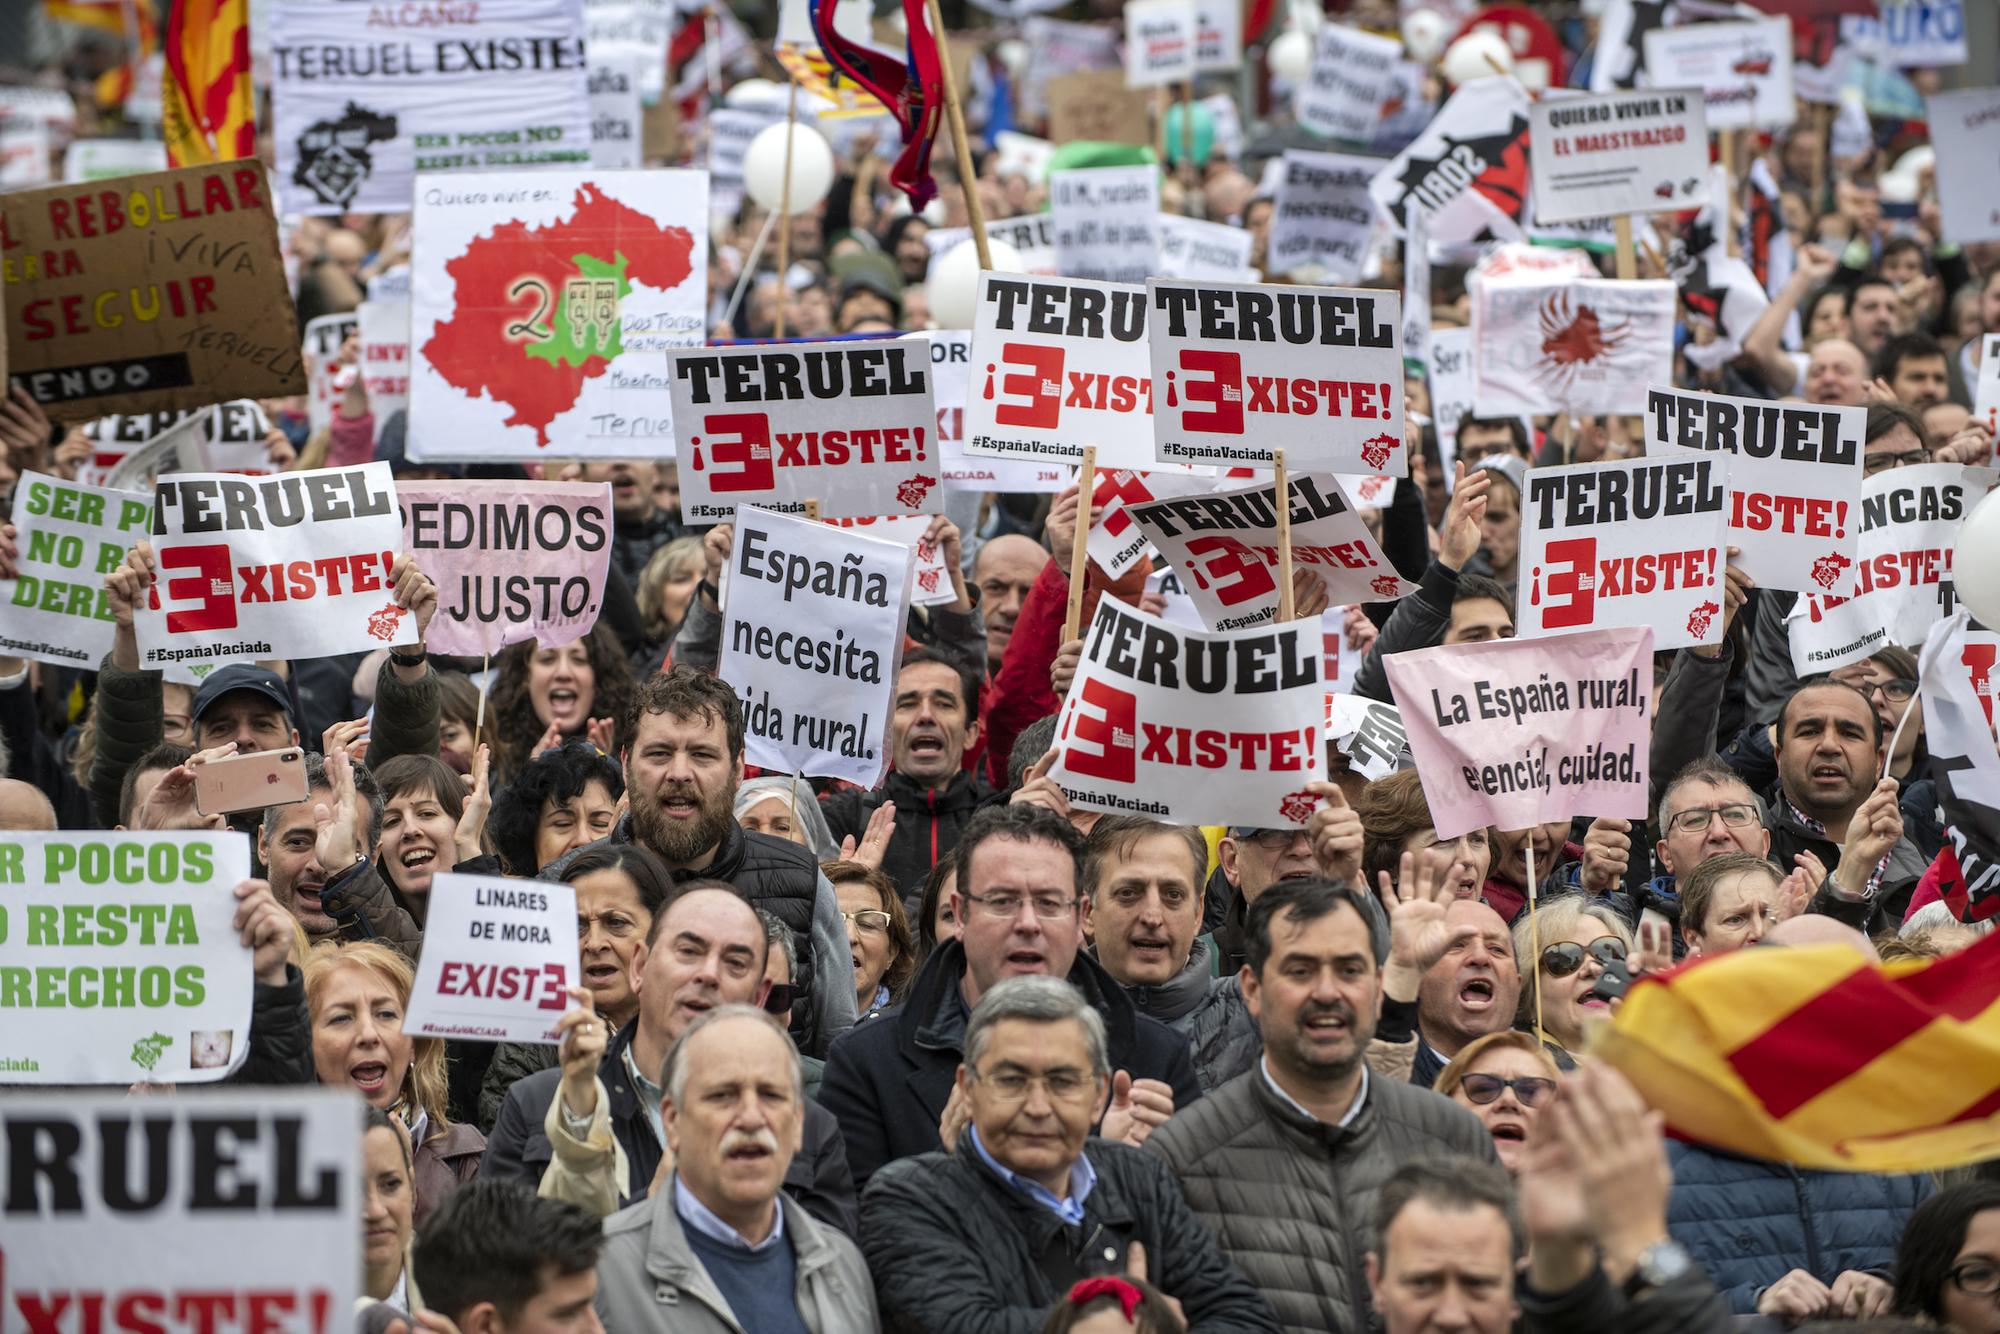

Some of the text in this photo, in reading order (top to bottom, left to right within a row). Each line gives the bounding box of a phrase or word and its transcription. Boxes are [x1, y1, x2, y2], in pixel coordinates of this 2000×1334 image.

[273, 37, 588, 80] TERUEL EXISTE!
[1549, 97, 1687, 128] QUIERO VIVIR EN
[1553, 125, 1686, 156] EL MAESTRAZGO
[0, 170, 263, 250] L REBOLLAR
[425, 188, 488, 207] Quiero
[3, 249, 84, 283] ERRA
[22, 276, 218, 341] SEGUIR
[986, 280, 1148, 342] TERU
[1155, 287, 1393, 348] TERUEL
[178, 324, 300, 385] TERUEL!
[676, 348, 926, 404] TERUEL
[11, 364, 150, 401] ENDO
[983, 342, 1153, 429] ¡EXIST
[590, 413, 672, 438] Terue
[972, 435, 1084, 457] #EspañaVaciada
[1648, 389, 1857, 466] TERUEL
[1163, 442, 1274, 462] #EspañaVaciada
[25, 481, 106, 527] SER
[153, 471, 391, 535] TERUEL
[1131, 476, 1348, 538] TERUEL
[1530, 460, 1724, 530] TERUEL
[1728, 490, 1849, 539] ISTE!
[27, 528, 84, 569] NO
[399, 503, 606, 552] EDIMOS
[740, 527, 889, 608] España
[11, 574, 117, 622] DERE
[450, 575, 596, 622] JUSTO.
[1215, 606, 1278, 632] #EspañaVa
[0, 635, 89, 661] EspañaVaciada
[147, 640, 272, 663] #EspañaVaciada
[732, 619, 881, 684] necesita
[1088, 601, 1318, 694] TERUEL
[1807, 626, 1887, 663] #SalvemosTeruel
[1431, 667, 1645, 727] La España rural,
[792, 712, 874, 760] rural.
[1056, 784, 1170, 816] spañaVaciada
[44, 841, 214, 885] POCOS
[475, 888, 548, 911] LINARES
[27, 904, 199, 946] RESTA
[470, 921, 552, 944] DE MORA
[0, 964, 206, 1009] RECHOS
[1, 1114, 342, 1216] RUEL
[10, 1288, 334, 1334] XISTE!
